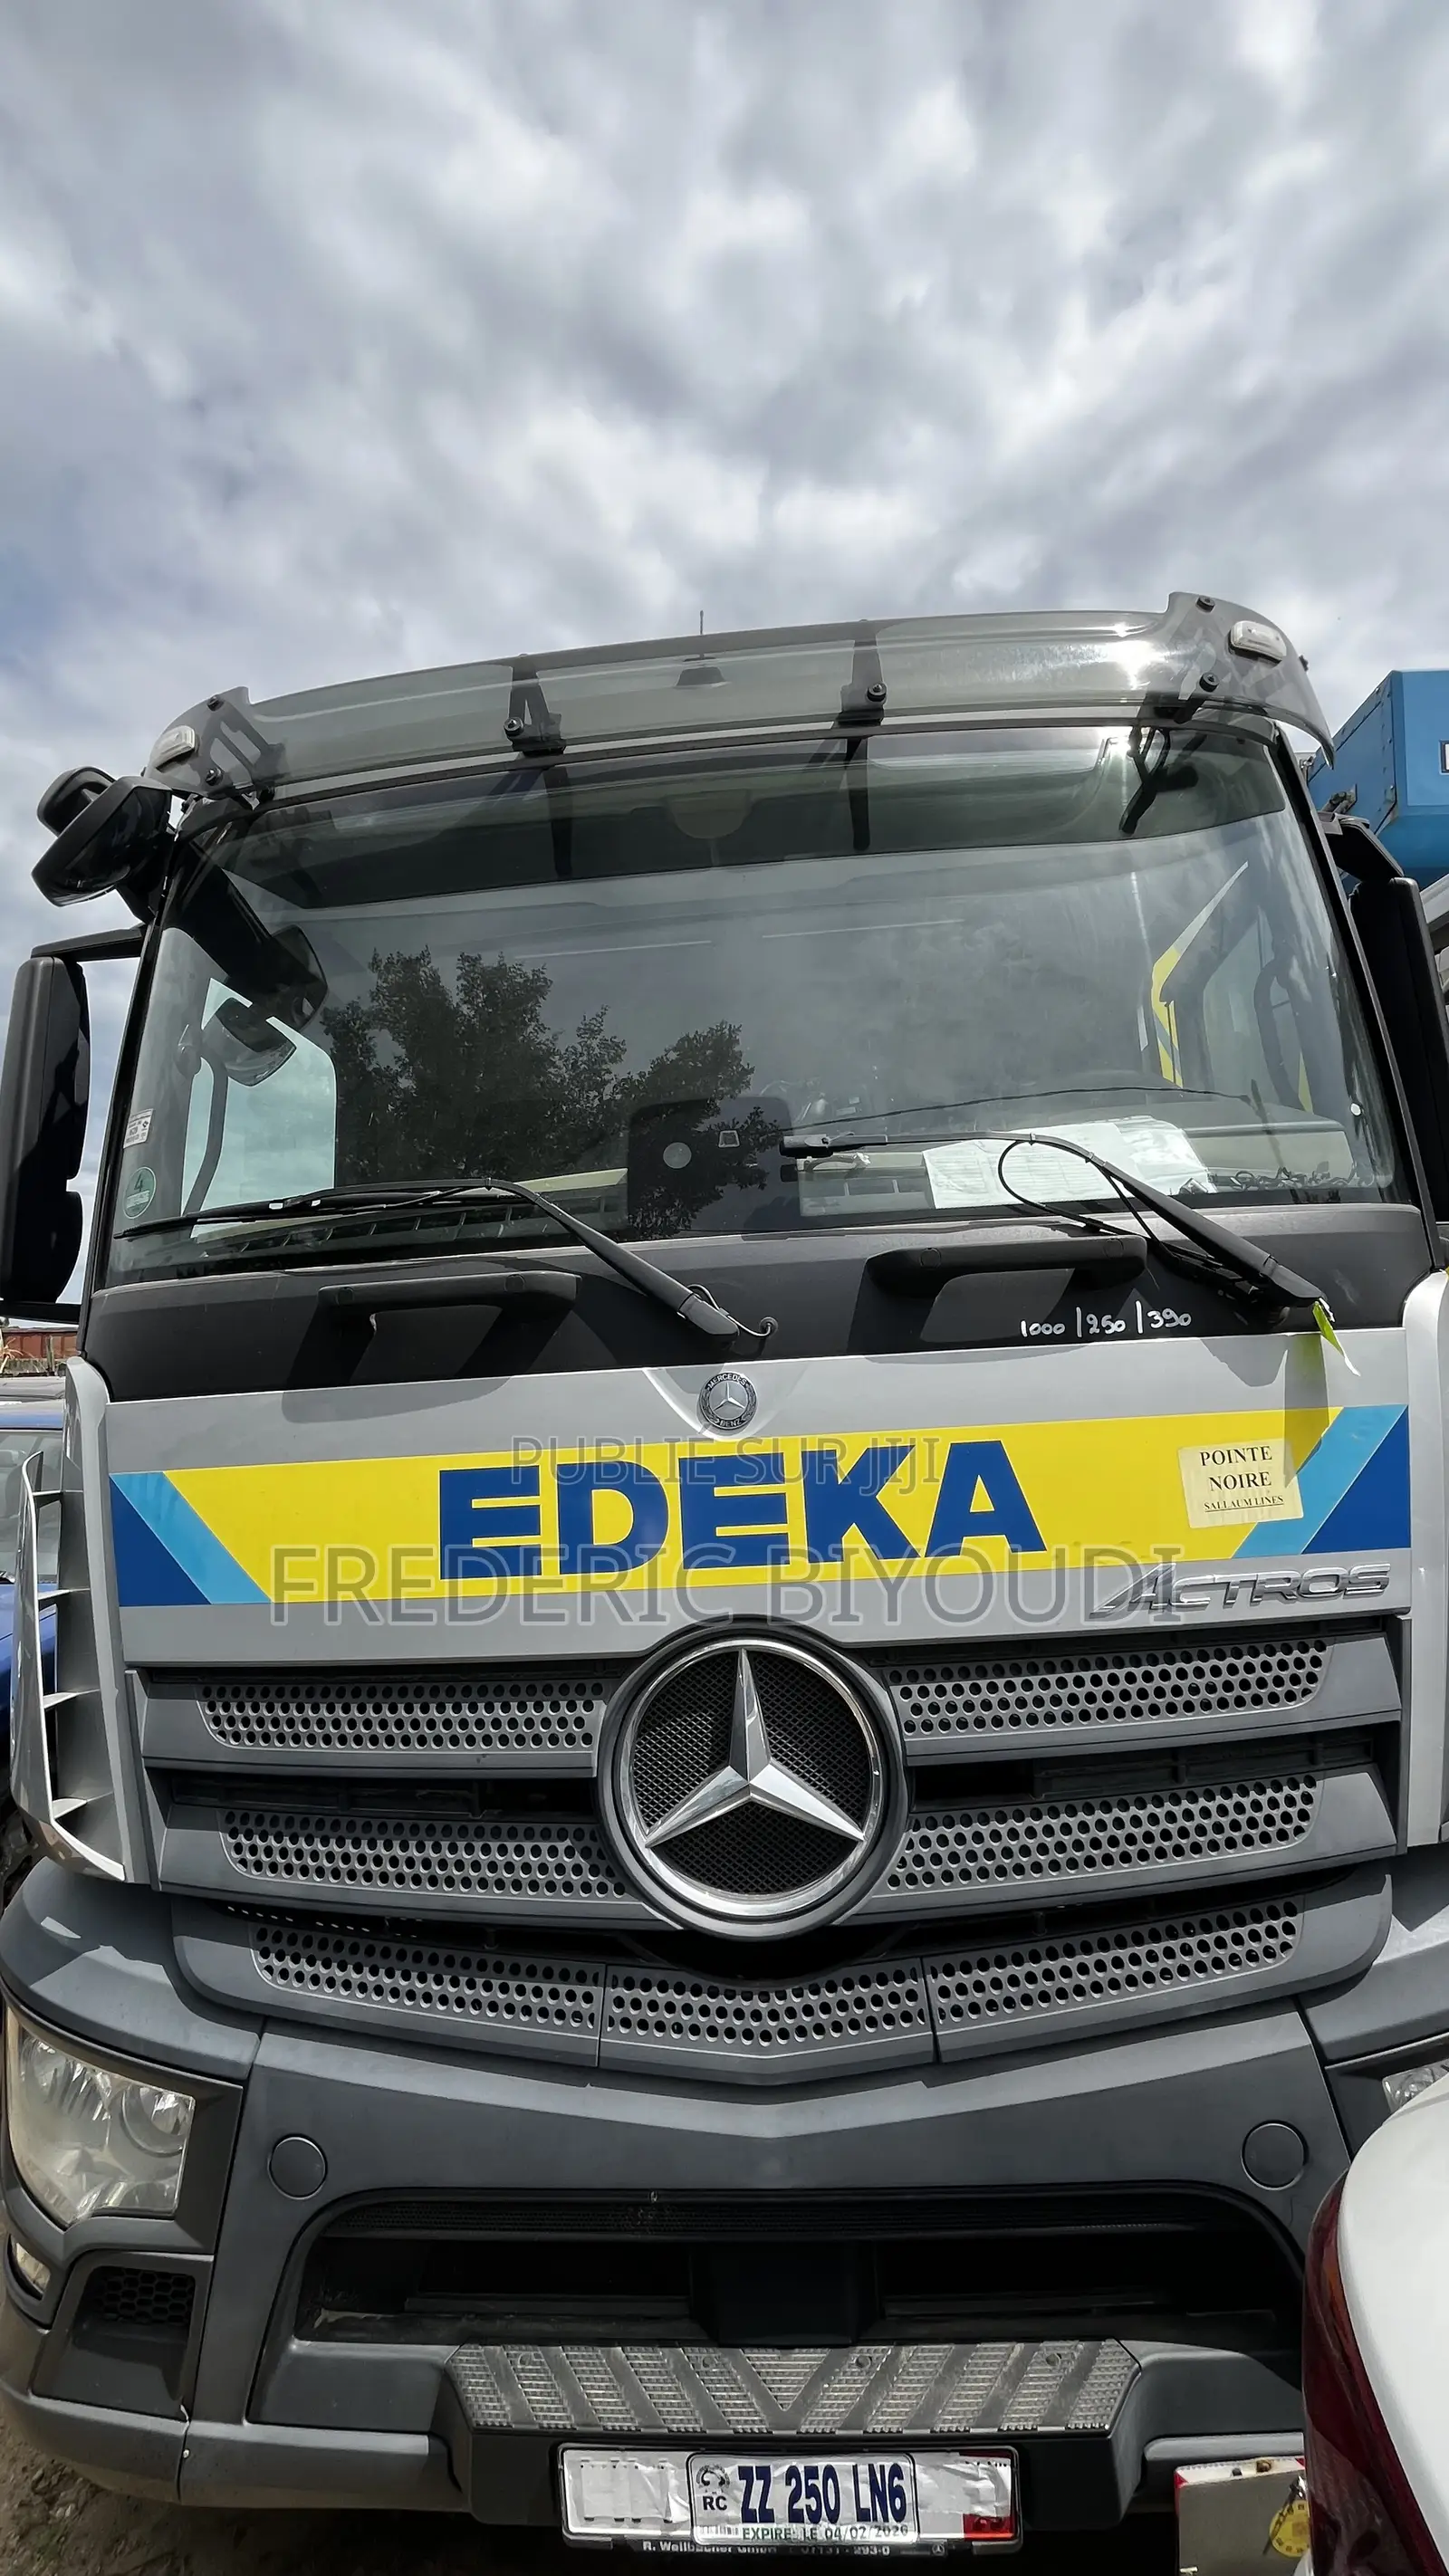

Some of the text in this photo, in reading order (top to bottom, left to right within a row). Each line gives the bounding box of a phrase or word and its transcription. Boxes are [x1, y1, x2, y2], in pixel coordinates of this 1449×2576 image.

[706, 1373, 748, 1389] MERCEDES
[1200, 1445, 1272, 1467] POINTE
[1209, 1471, 1272, 1491] NOIRE
[439, 1440, 1047, 1581] EDEKA
[1204, 1495, 1284, 1511] SALLAUM LINES
[737, 2465, 775, 2524] ZZ
[784, 2464, 841, 2524] 250
[851, 2462, 907, 2523] LN6
[702, 2495, 728, 2511] RC
[803, 2527, 818, 2541] LE
